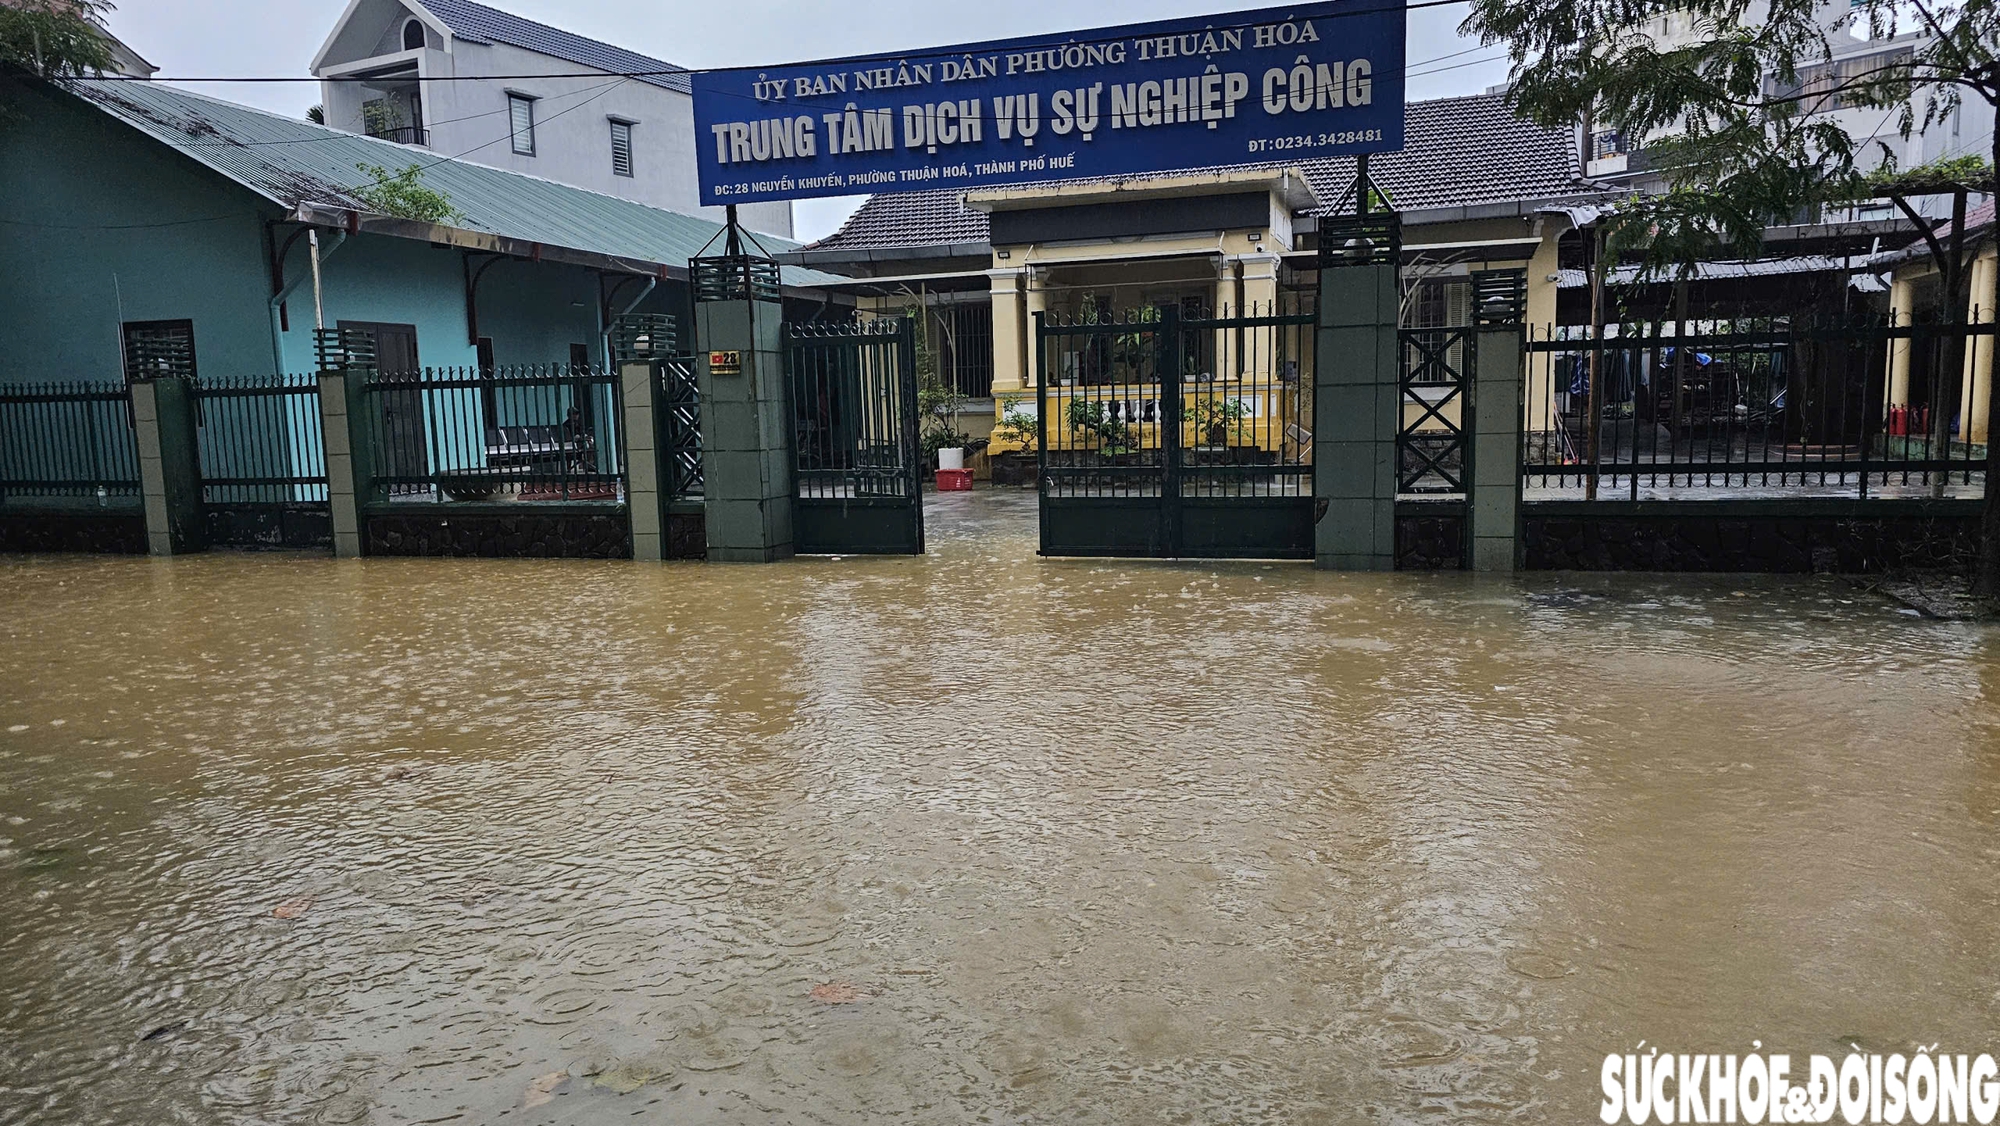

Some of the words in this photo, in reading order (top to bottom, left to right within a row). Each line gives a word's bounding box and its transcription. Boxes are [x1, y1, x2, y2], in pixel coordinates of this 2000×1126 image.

[752, 73, 789, 100] ỦY
[794, 72, 847, 97] BAN
[854, 59, 933, 91] NHÂN
[941, 54, 998, 82] DÂN
[1005, 38, 1126, 75] PHƯỜNG
[1135, 24, 1244, 60] THUẬN
[1252, 14, 1320, 48] HÓA
[711, 115, 817, 164] TRUNG
[822, 102, 894, 155] TÂM
[903, 98, 983, 154] DỊCH
[993, 92, 1040, 147] VỤ
[1051, 81, 1103, 142] SỰ
[1111, 64, 1249, 130] NGHIỆP
[1262, 54, 1372, 115] CÔNG
[751, 173, 795, 193] NGUYỄN
[797, 170, 846, 189] KHUYẾN,
[848, 168, 896, 185] PHƯỜNG
[899, 165, 939, 181] THUẬN
[943, 162, 973, 179] HOÁ,
[974, 159, 1016, 175] THÀNH
[1019, 153, 1045, 171] PHỐ
[1049, 151, 1076, 169] HUẾ
[723, 352, 736, 365] 28
